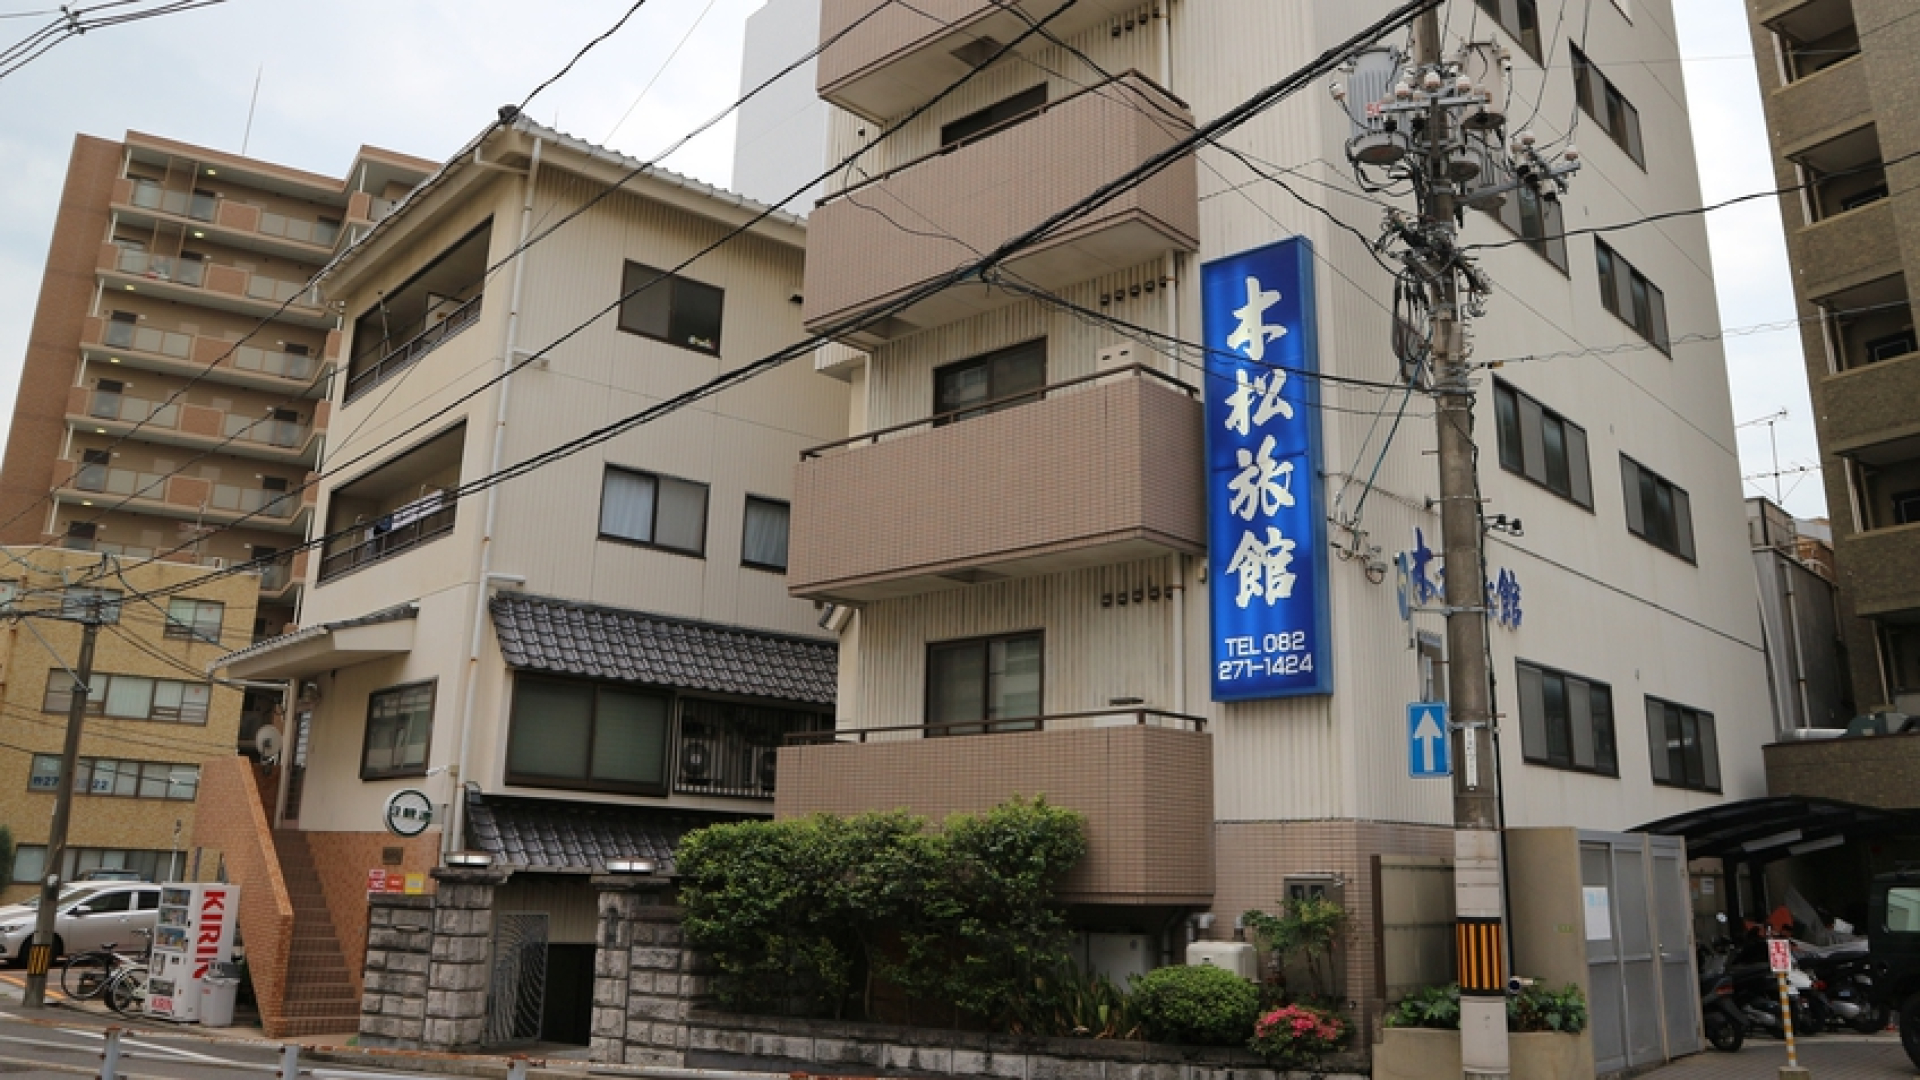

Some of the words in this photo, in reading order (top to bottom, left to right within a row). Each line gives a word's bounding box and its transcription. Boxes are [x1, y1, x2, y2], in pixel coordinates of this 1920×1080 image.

[1224, 635, 1261, 657] TEL
[1263, 631, 1305, 653] 082
[1217, 652, 1313, 680] 271-1424
